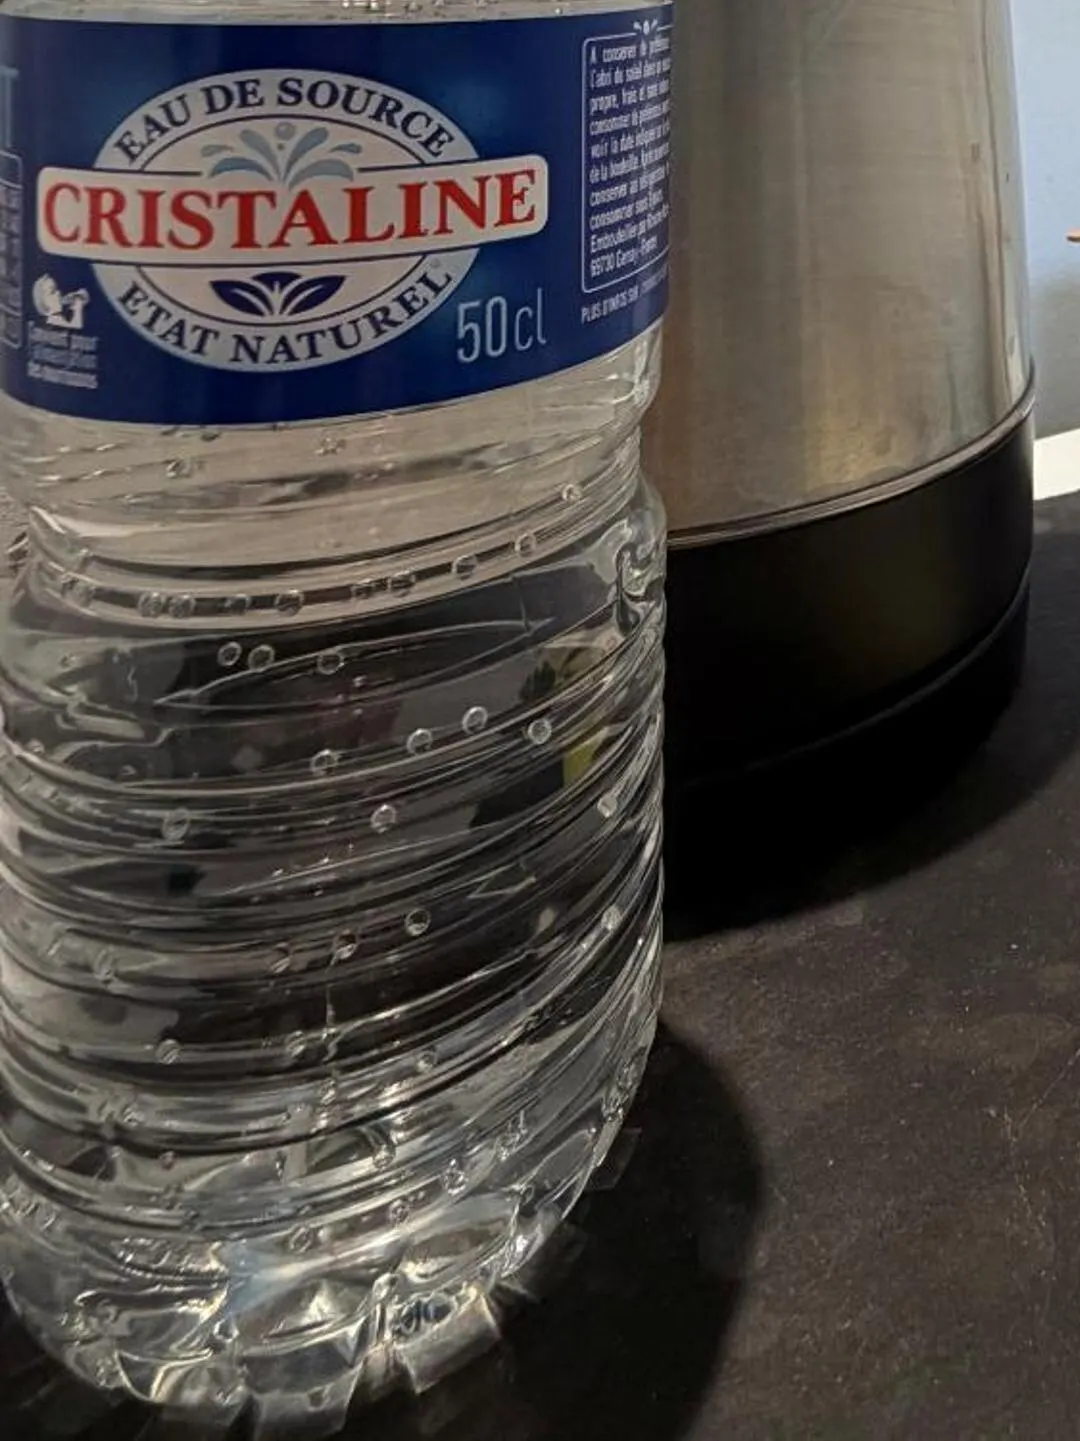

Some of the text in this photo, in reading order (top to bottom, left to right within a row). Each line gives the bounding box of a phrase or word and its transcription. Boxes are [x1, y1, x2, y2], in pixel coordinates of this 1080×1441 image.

[114, 77, 455, 164] EAU DE SOURCE
[43, 168, 537, 251] CRISTALINE
[118, 271, 454, 364] ETAT NATUREL
